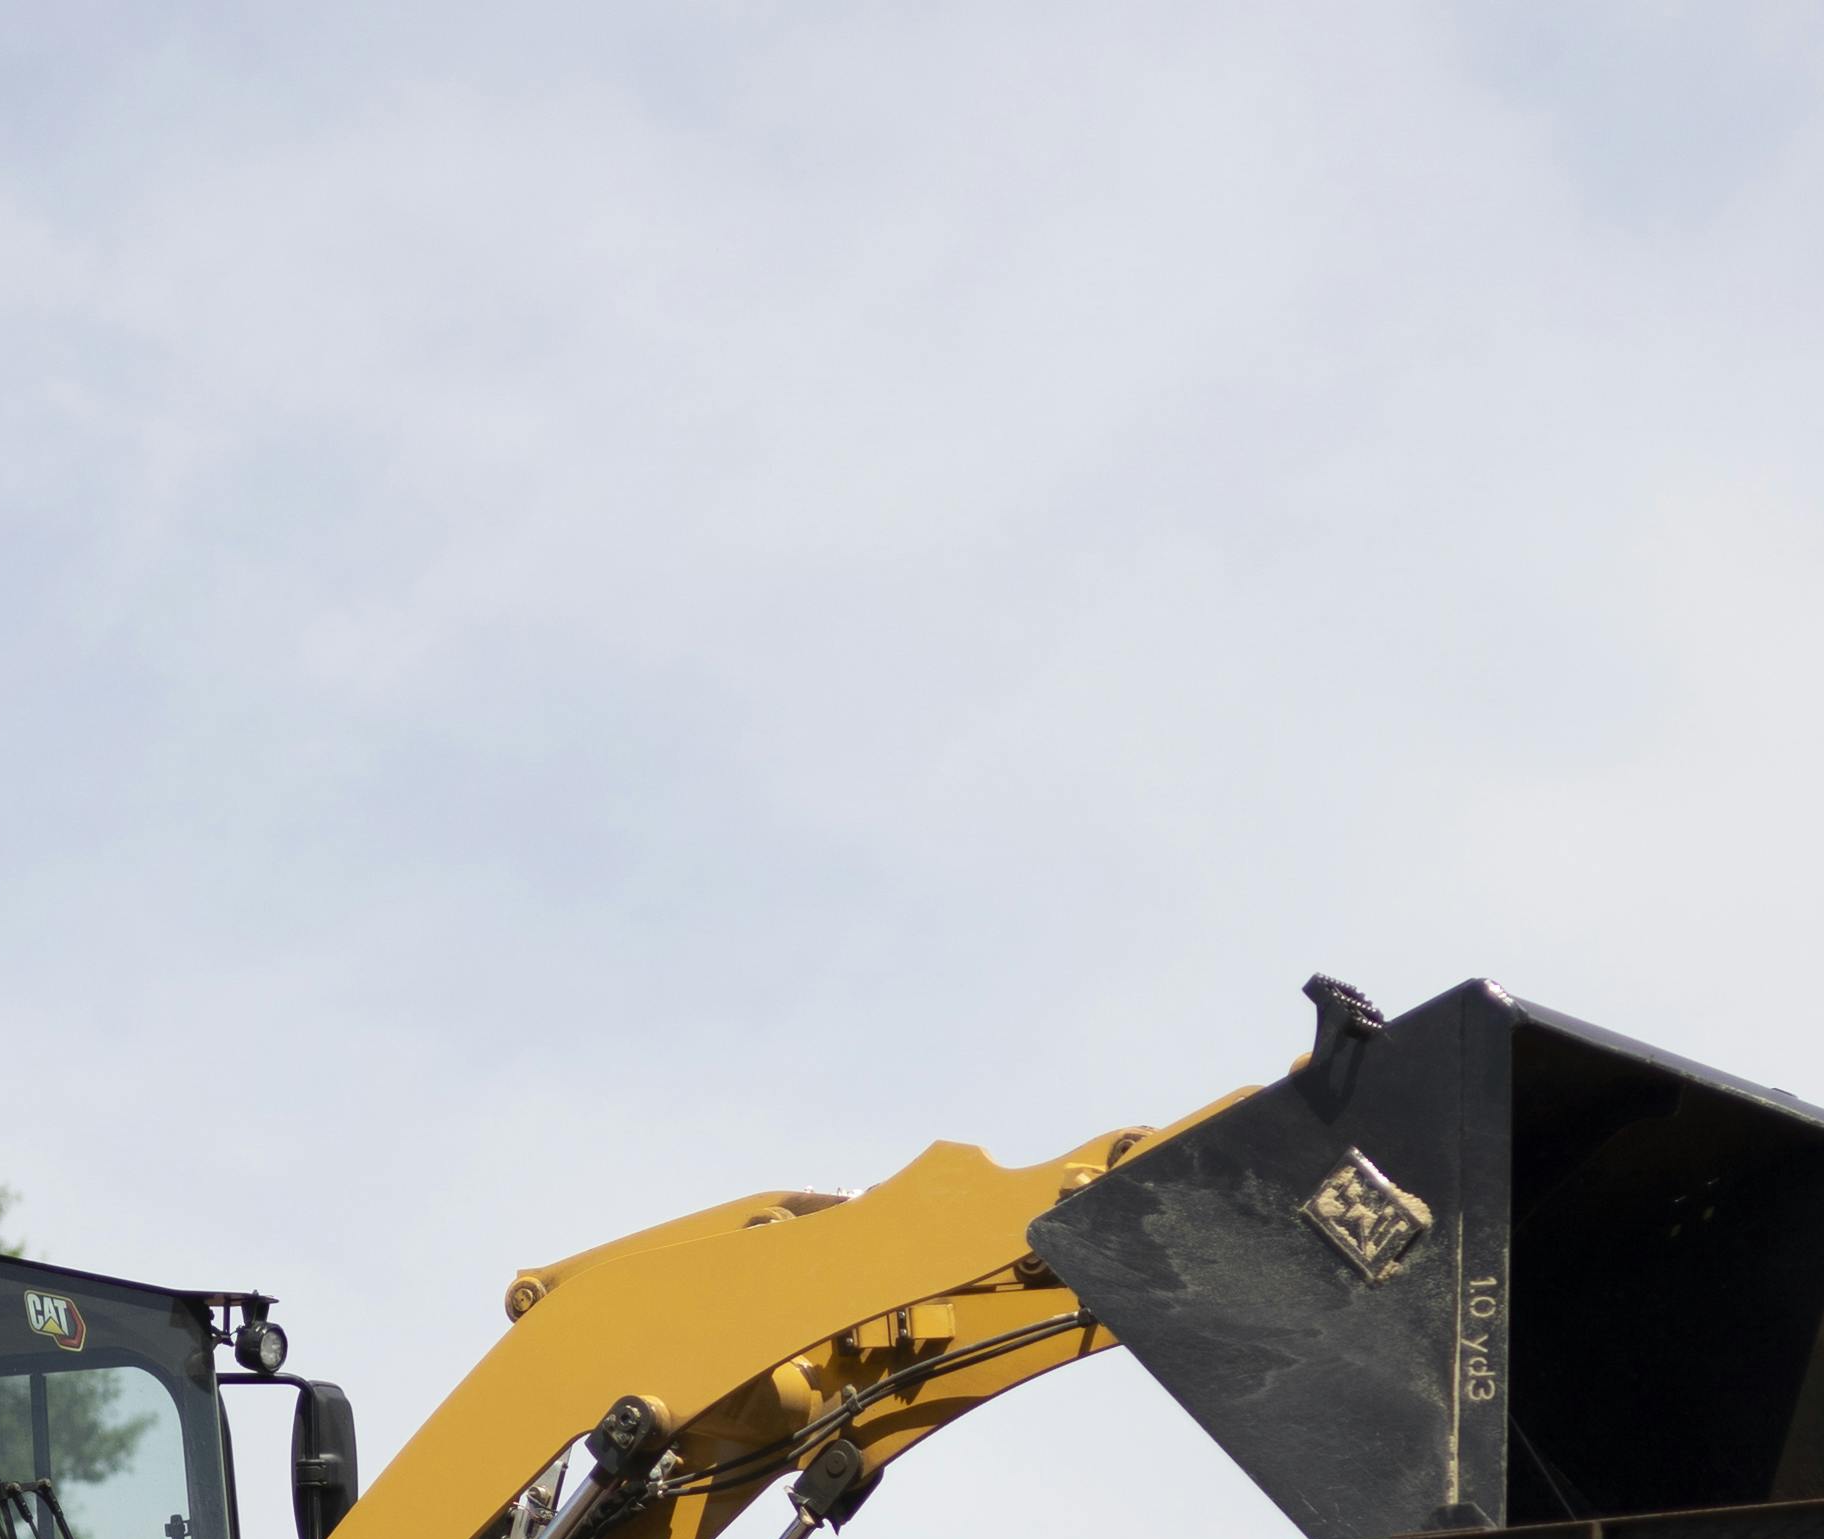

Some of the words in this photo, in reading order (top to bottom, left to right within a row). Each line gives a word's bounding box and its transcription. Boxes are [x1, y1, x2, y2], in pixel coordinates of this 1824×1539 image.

[26, 1293, 69, 1336] CAT
[1469, 1276, 1497, 1318] 1.0
[1461, 1335, 1496, 1401] yd3
